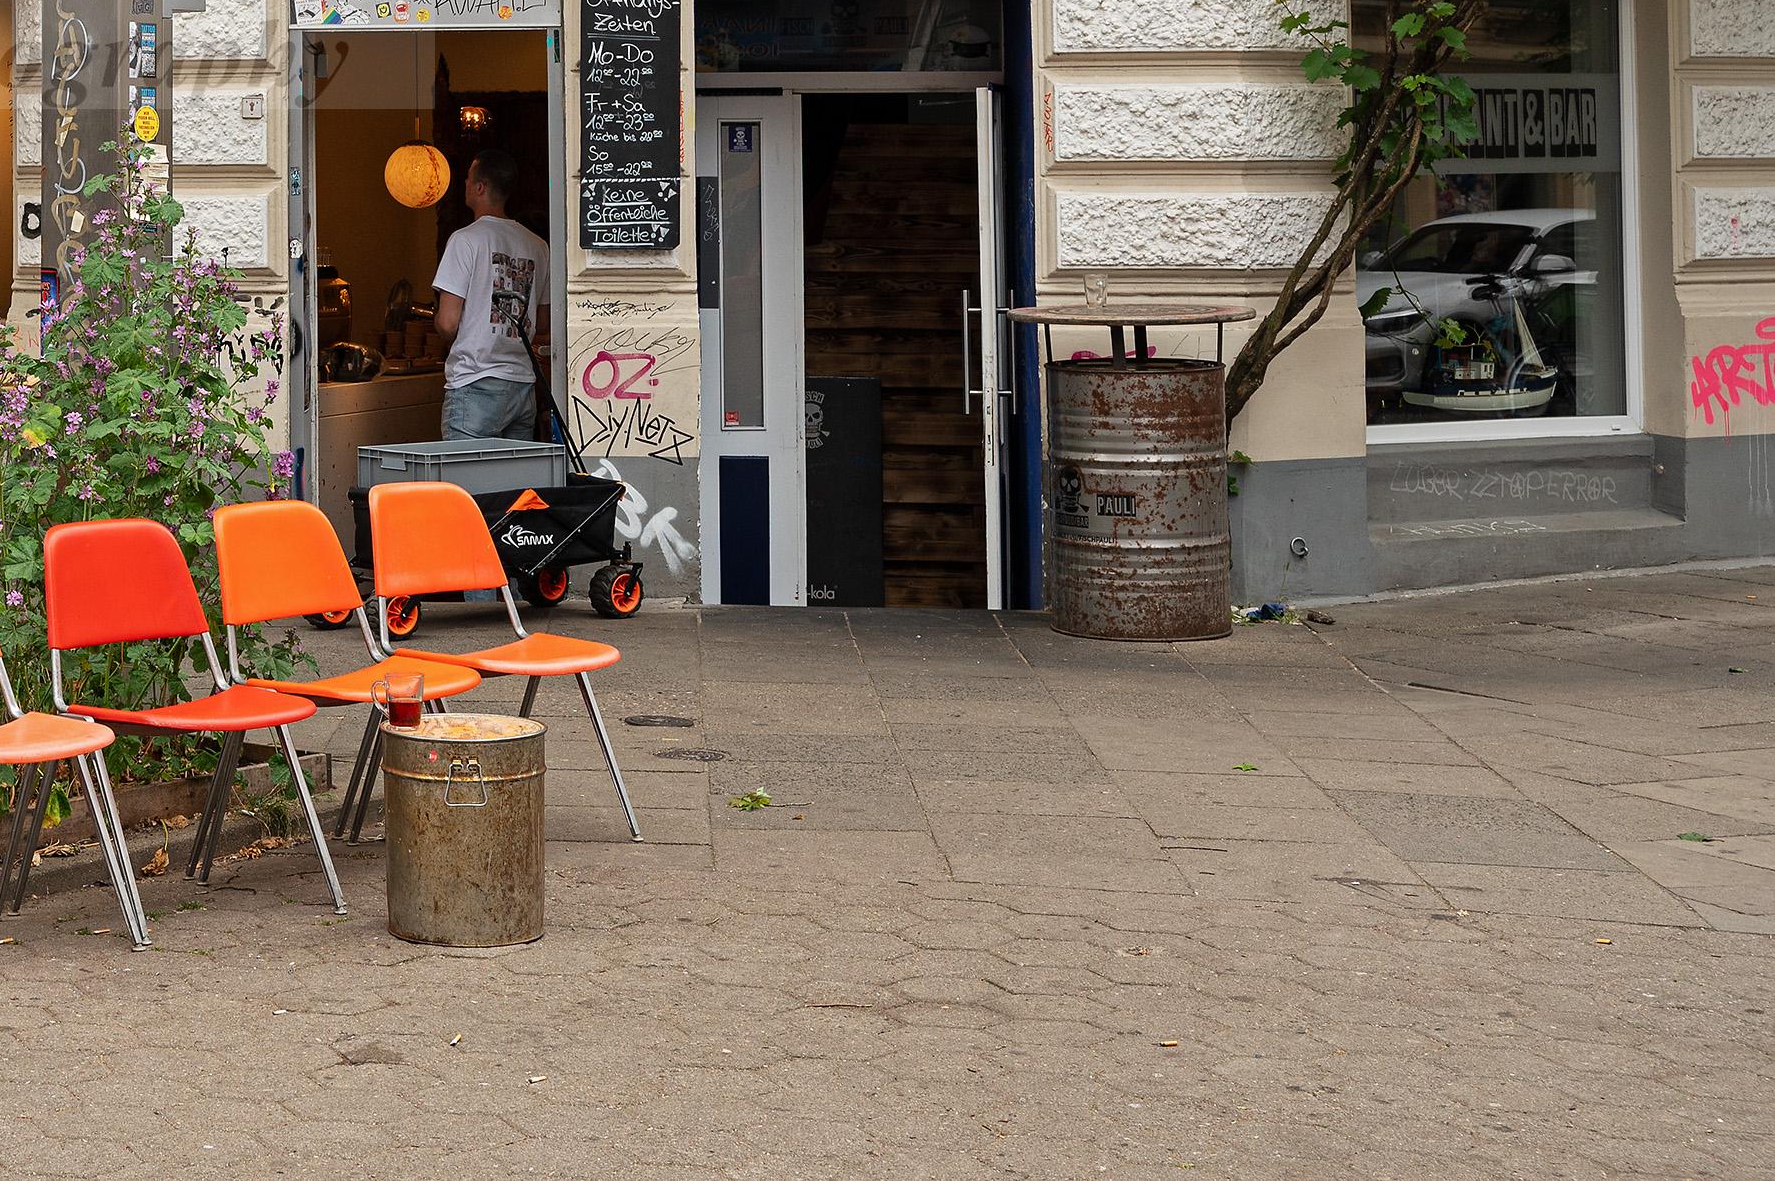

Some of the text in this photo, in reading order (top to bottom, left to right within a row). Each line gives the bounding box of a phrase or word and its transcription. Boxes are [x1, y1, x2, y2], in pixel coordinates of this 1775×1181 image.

[593, 12, 656, 35] Zeiten
[587, 41, 655, 66] Mo-Do
[1550, 93, 1596, 146] BAR
[589, 131, 620, 142] Küche
[623, 131, 637, 142] bis
[587, 146, 609, 161] So
[602, 185, 648, 202] Keine
[591, 227, 651, 243] Toilette
[1096, 495, 1137, 516] PAULI
